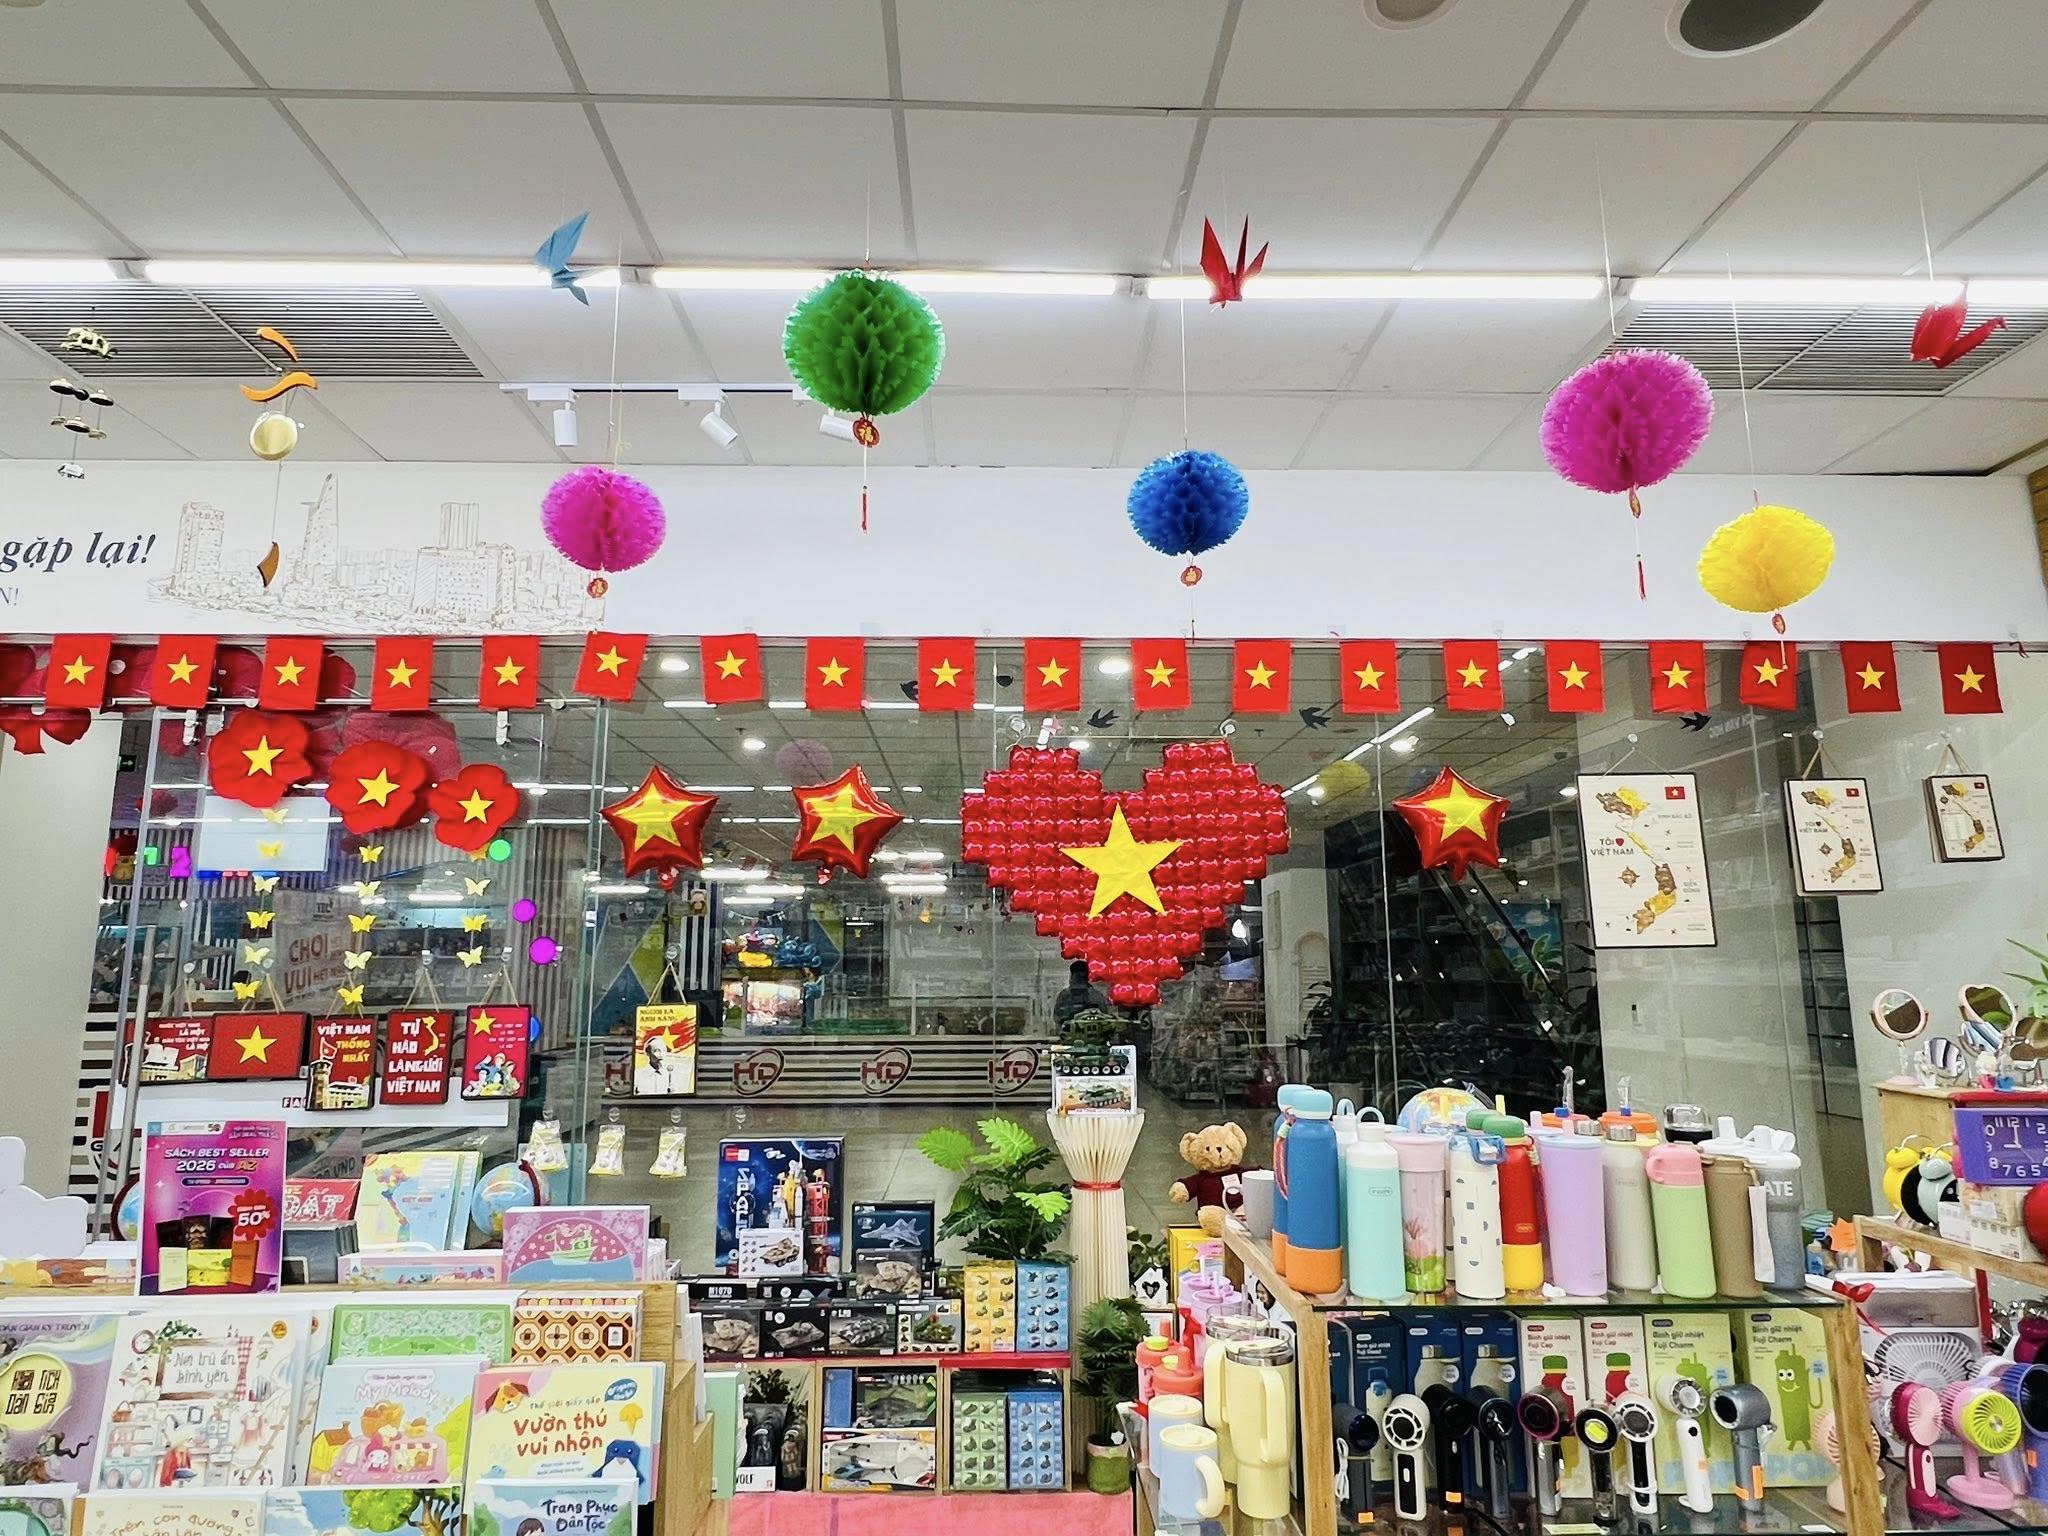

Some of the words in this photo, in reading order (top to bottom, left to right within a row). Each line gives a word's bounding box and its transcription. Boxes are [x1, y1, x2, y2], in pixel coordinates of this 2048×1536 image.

[0, 537, 73, 573] gặp
[86, 531, 156, 568] lại!
[1600, 837, 1615, 846] TÔI
[1613, 848, 1634, 856] NAM
[284, 966, 312, 994] VUI
[317, 1022, 342, 1037] VIỆT
[345, 1023, 372, 1035] NAM
[401, 1018, 422, 1037] TỰ
[336, 1036, 371, 1049] THỐNG
[392, 1039, 418, 1055] HÀO
[342, 1050, 370, 1063] NHẤT
[734, 1063, 778, 1080] HD
[862, 1062, 906, 1079] HD
[989, 1061, 1033, 1079] HD
[387, 1076, 414, 1096] VIỆT
[415, 1079, 441, 1093] NAM
[1994, 1117, 2004, 1128] 11
[2007, 1116, 2019, 1128] 12
[2036, 1123, 2046, 1134] 2
[1985, 1125, 1995, 1136] 0
[164, 1146, 195, 1158] SÁCH
[198, 1148, 227, 1158] BEST
[229, 1147, 270, 1158] SELLER
[176, 1160, 216, 1172] 2026
[236, 1160, 257, 1171] AZ
[1989, 1157, 1999, 1169] 8
[2002, 1165, 2011, 1176] 7
[2031, 1165, 2041, 1176] 5
[2016, 1166, 2026, 1177] 6
[238, 1209, 271, 1227] 50%
[356, 1384, 380, 1402] My
[386, 1382, 440, 1406] Melody
[574, 1408, 608, 1430] thú
[517, 1436, 548, 1457] vui
[554, 1431, 603, 1456] nhộn
[541, 1499, 583, 1516] Trang
[586, 1499, 618, 1516] Phục
[556, 1516, 583, 1532] Dân
[584, 1515, 606, 1533] Tộc
